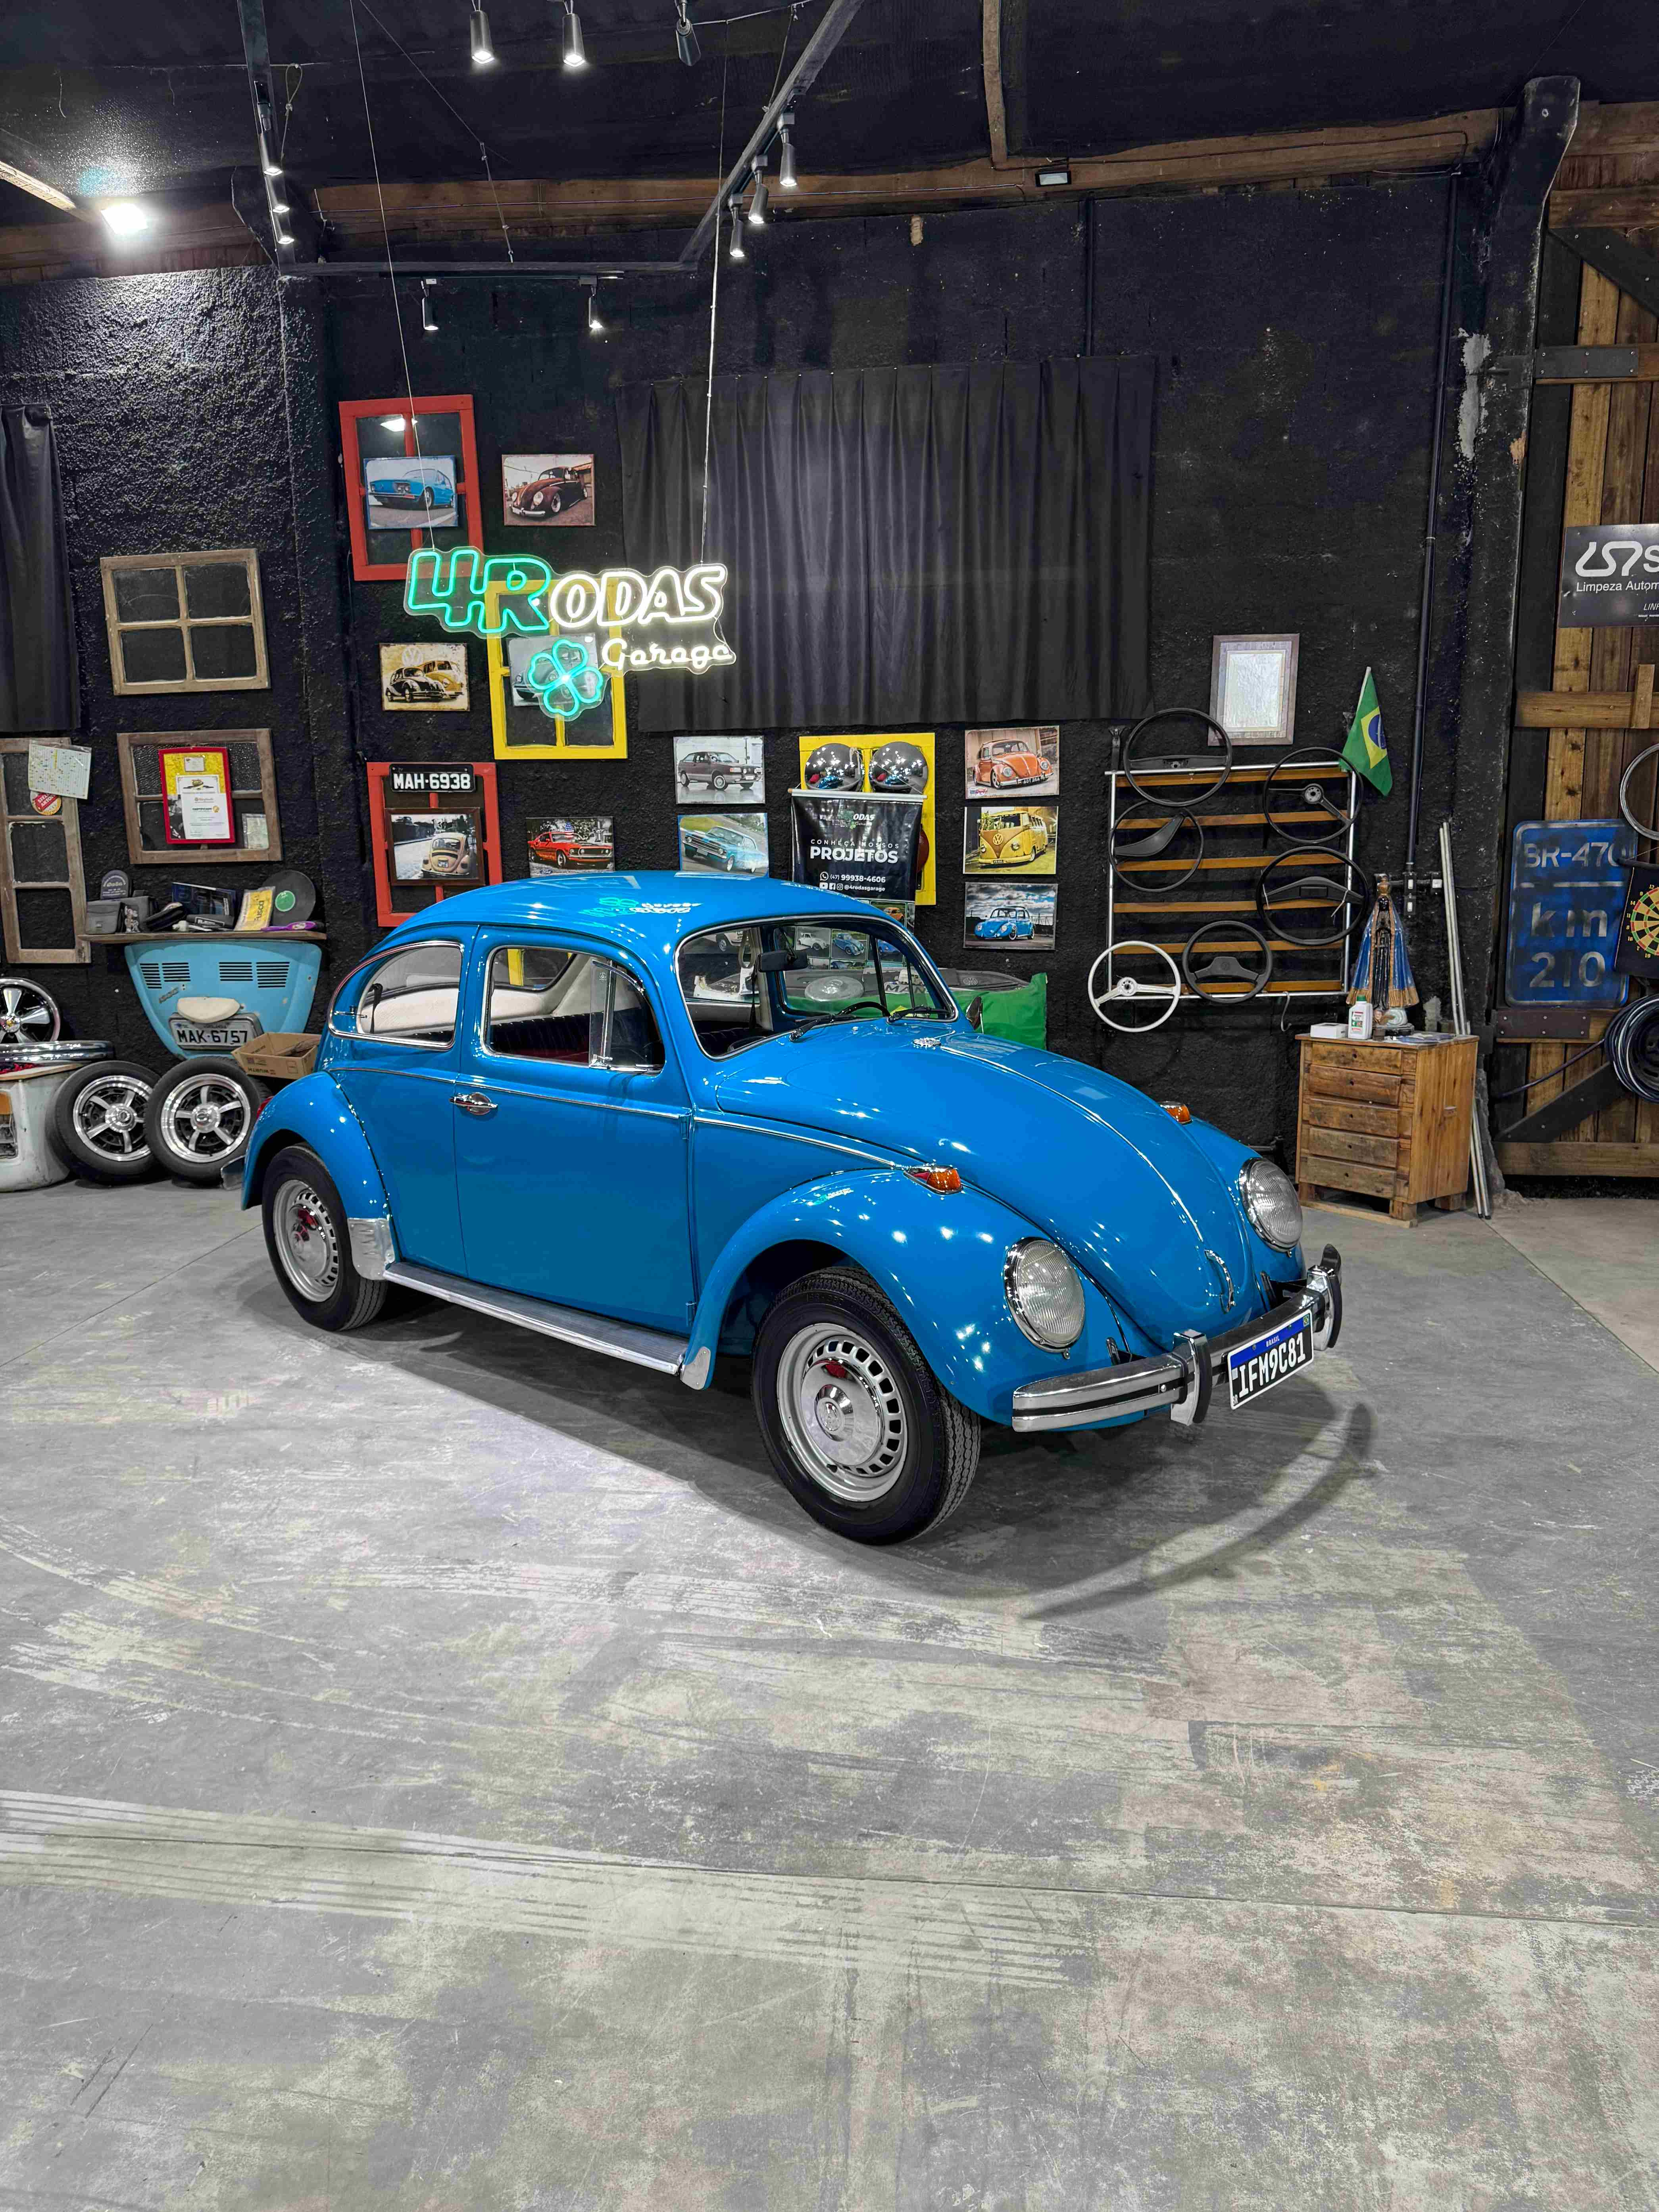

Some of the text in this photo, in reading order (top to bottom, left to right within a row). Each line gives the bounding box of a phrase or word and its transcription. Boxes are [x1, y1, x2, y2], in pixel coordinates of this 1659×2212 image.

[1576, 582, 1622, 594] Limpeza
[602, 637, 732, 671] Garage
[811, 839, 855, 847] CONHEÇA
[810, 846, 898, 864] PROJETOS
[841, 874, 886, 883] 99938-4606
[1531, 902, 1607, 937] km
[1530, 951, 1605, 987] 210
[1266, 1335, 1280, 1347] BRASIL
[1239, 1332, 1306, 1398] IFM9C81
